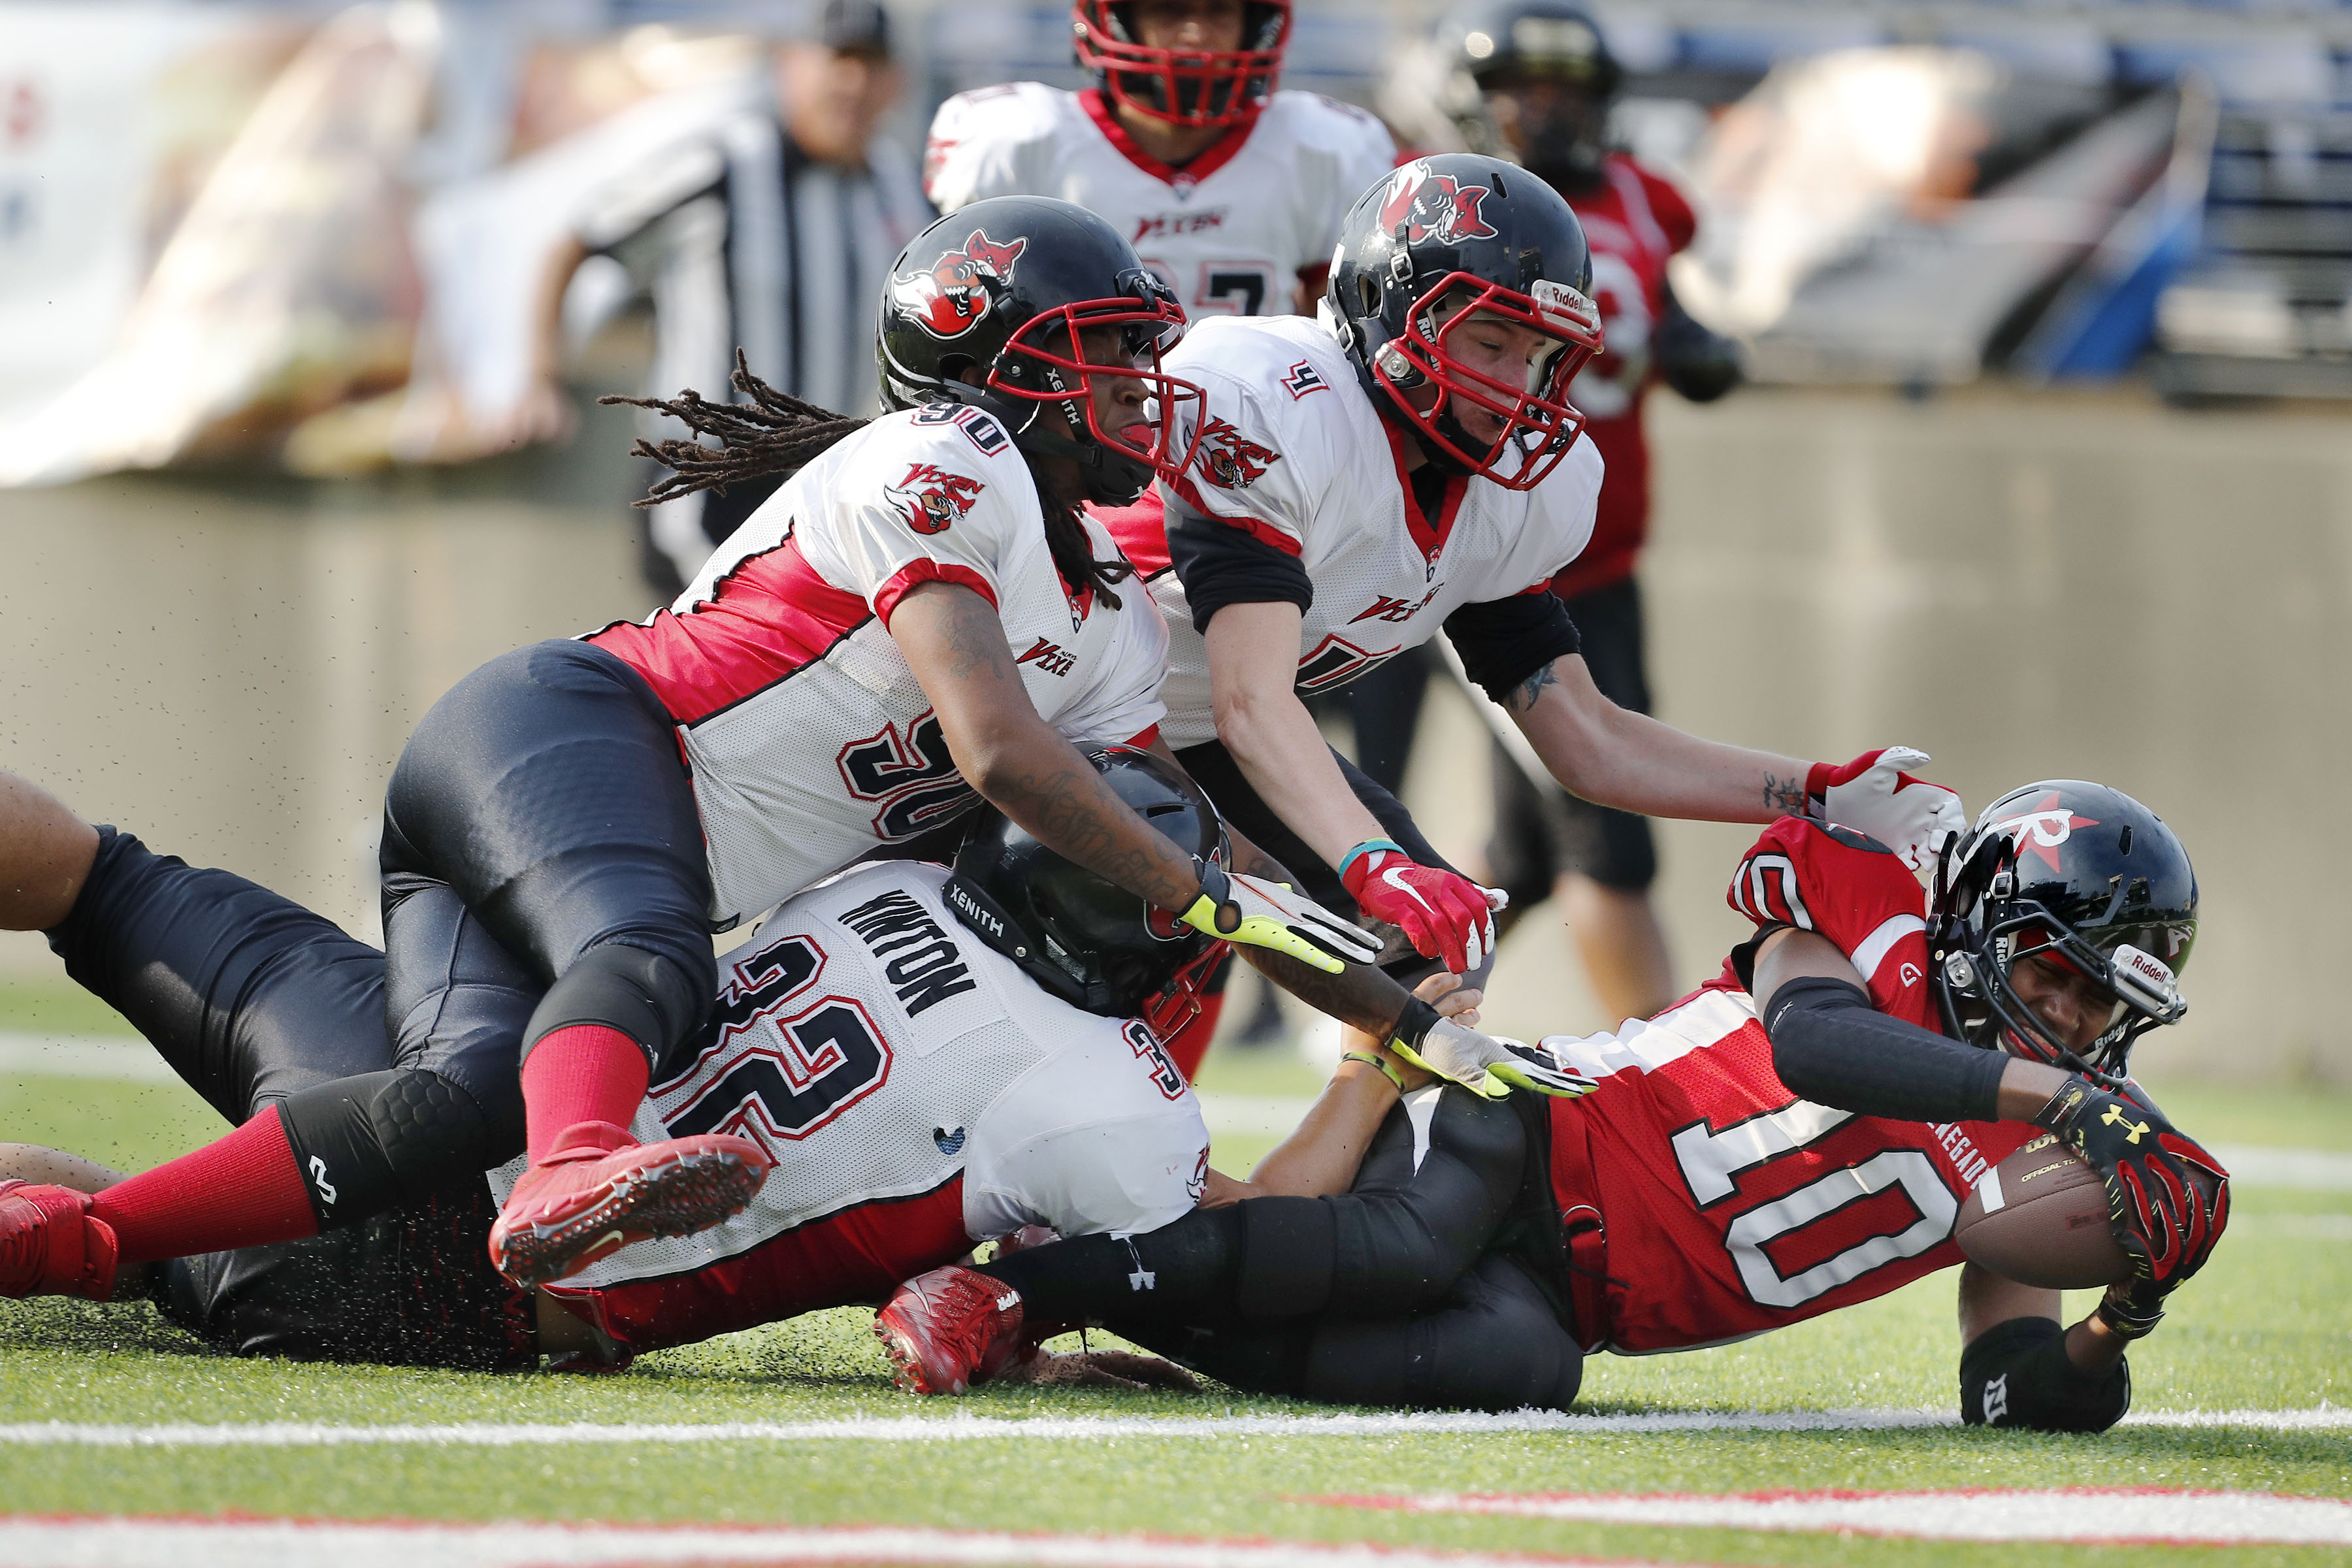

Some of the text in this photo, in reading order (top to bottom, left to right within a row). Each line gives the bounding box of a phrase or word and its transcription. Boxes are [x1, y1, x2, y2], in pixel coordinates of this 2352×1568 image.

[1552, 286, 1584, 312] Riddell
[1046, 367, 1081, 424] XEITH
[1281, 359, 1330, 401] 4
[910, 402, 1009, 457] 90
[1202, 415, 1282, 465] VIXEN
[895, 463, 986, 495] VIXEN
[950, 883, 1005, 938] XENITH
[838, 889, 977, 1019] WINTON
[2131, 955, 2168, 983] Riddell
[2021, 1162, 2063, 1183] OFFICIAL
[1670, 1098, 1959, 1309] 10
